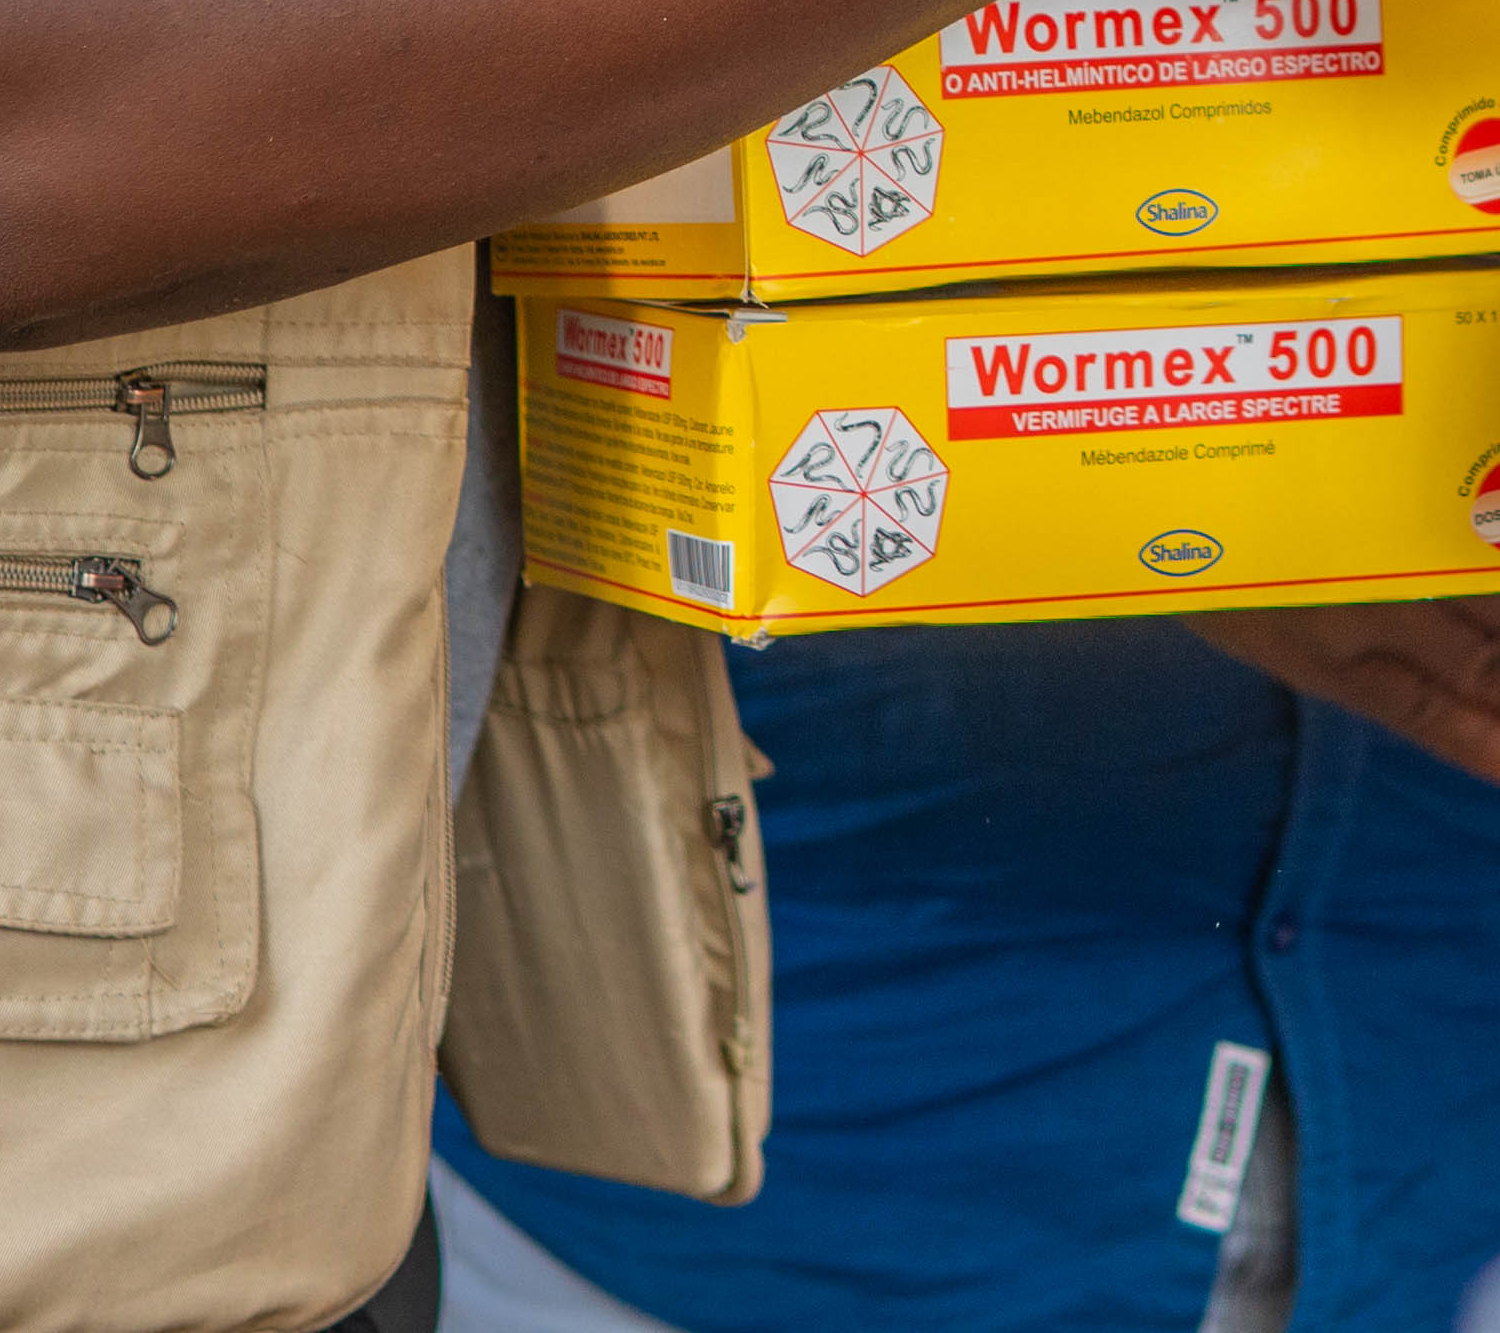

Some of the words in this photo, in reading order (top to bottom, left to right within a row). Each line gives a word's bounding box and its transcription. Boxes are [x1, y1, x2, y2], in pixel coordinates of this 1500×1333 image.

[944, 73, 963, 94] O
[966, 61, 1153, 94] ANTI-HELMÍNTICO
[1159, 60, 1188, 82] DE
[1192, 55, 1267, 81] LARGO
[1271, 49, 1381, 76] ESPECTRO
[1068, 102, 1164, 125] Mebendazol
[1169, 99, 1272, 124] Comprimidos
[1435, 96, 1496, 167] Comprimido
[1459, 168, 1492, 184] TOMA
[1146, 201, 1208, 223] Shalina
[1455, 311, 1472, 325] 50
[1477, 311, 1485, 323] X
[632, 329, 664, 369] 500
[1267, 326, 1377, 380] 500
[1012, 405, 1139, 433] VERMIFUGE
[1143, 403, 1160, 424] A
[1164, 398, 1238, 422] LARGE
[1241, 393, 1341, 418] SPECTRE
[1081, 443, 1189, 467] Mébendazole
[1194, 439, 1276, 462] Comprimé
[1149, 540, 1213, 563] Shalina
